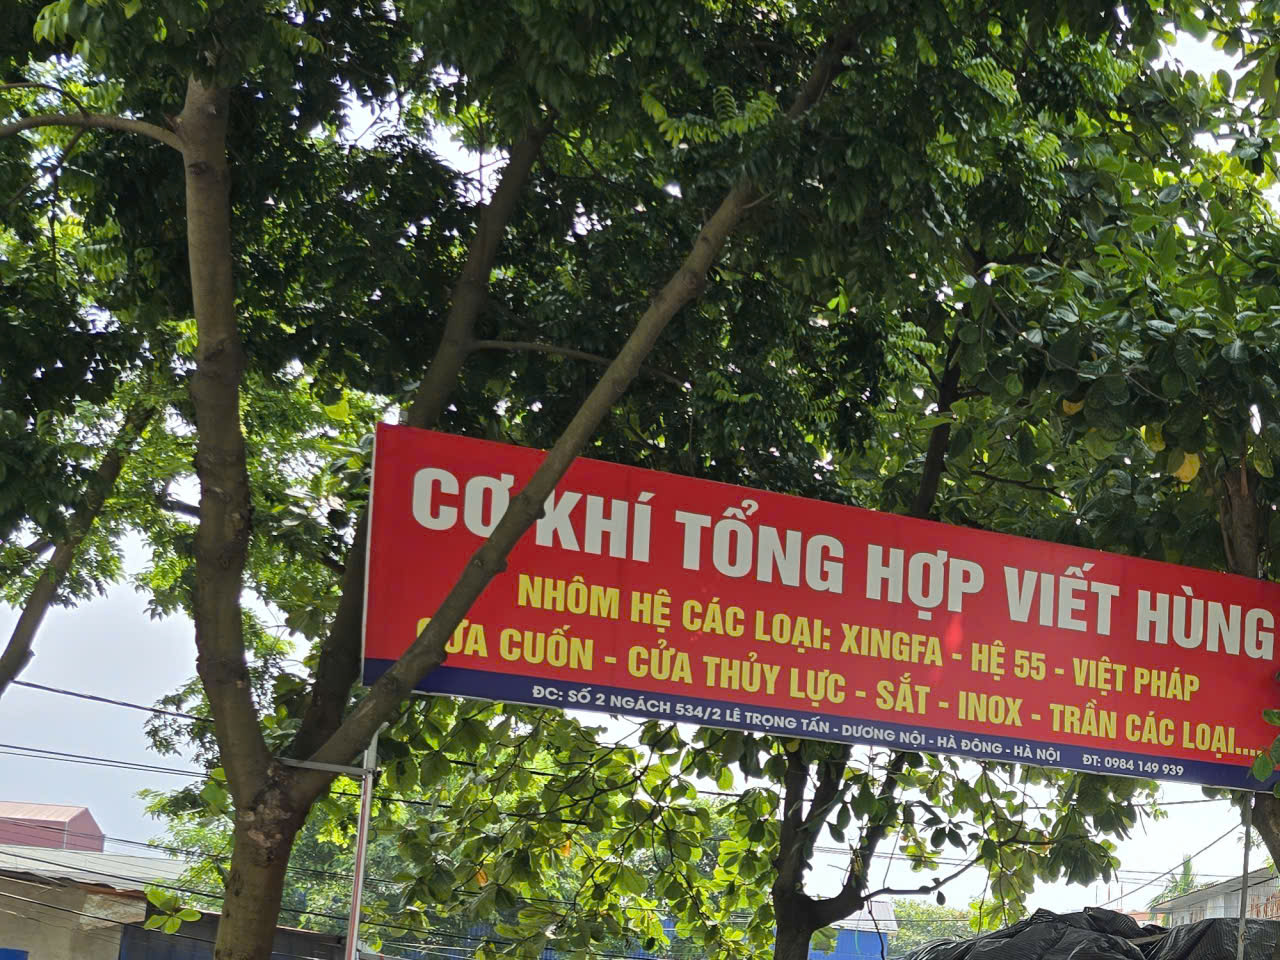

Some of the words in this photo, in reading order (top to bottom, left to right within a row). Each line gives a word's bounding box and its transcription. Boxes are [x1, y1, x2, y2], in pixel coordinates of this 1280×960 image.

[412, 467, 515, 539] CƠ
[535, 489, 655, 563] KHÍ
[674, 498, 844, 595] TỔNG
[865, 543, 985, 621] HỢP
[1003, 562, 1120, 636] VIẾT
[1135, 585, 1275, 661] HÙNG
[499, 624, 594, 671] CUỐN
[627, 638, 693, 685] CỬA
[702, 651, 781, 695] THỦY
[789, 667, 846, 708] LỰC
[875, 671, 931, 715] SẮT
[957, 690, 1024, 727] INOX
[1049, 698, 1118, 740] TRẦN
[1125, 710, 1175, 747] CÁC
[517, 573, 620, 620] NHÔM
[630, 588, 672, 634] HỆ
[682, 596, 745, 638] CÁC
[753, 611, 832, 657] LOẠI:
[839, 623, 944, 667] XINGFA
[970, 639, 1006, 682] HỆ
[1013, 648, 1047, 681] 55
[1072, 655, 1128, 697] VIỆT
[1133, 663, 1201, 703] PHÁP
[532, 685, 564, 701] ĐC:
[567, 687, 592, 704] SỐ
[595, 693, 606, 706] 2
[609, 694, 671, 714] NGÁCH
[674, 703, 721, 721] 534/2
[724, 706, 753, 726] LÊ
[754, 710, 798, 732] TRỌNG
[800, 715, 830, 734] TẤN
[841, 724, 896, 742] DƯƠNG
[899, 729, 926, 749] NỘI
[936, 734, 958, 750] HÀ
[960, 737, 1003, 754] ĐÔNG
[1013, 743, 1033, 759] HÀ
[1036, 746, 1061, 764] NỘI
[1082, 753, 1102, 767] ĐT:
[1104, 756, 1135, 771] 0984
[1137, 760, 1160, 774] 149
[1161, 763, 1184, 776] 939
